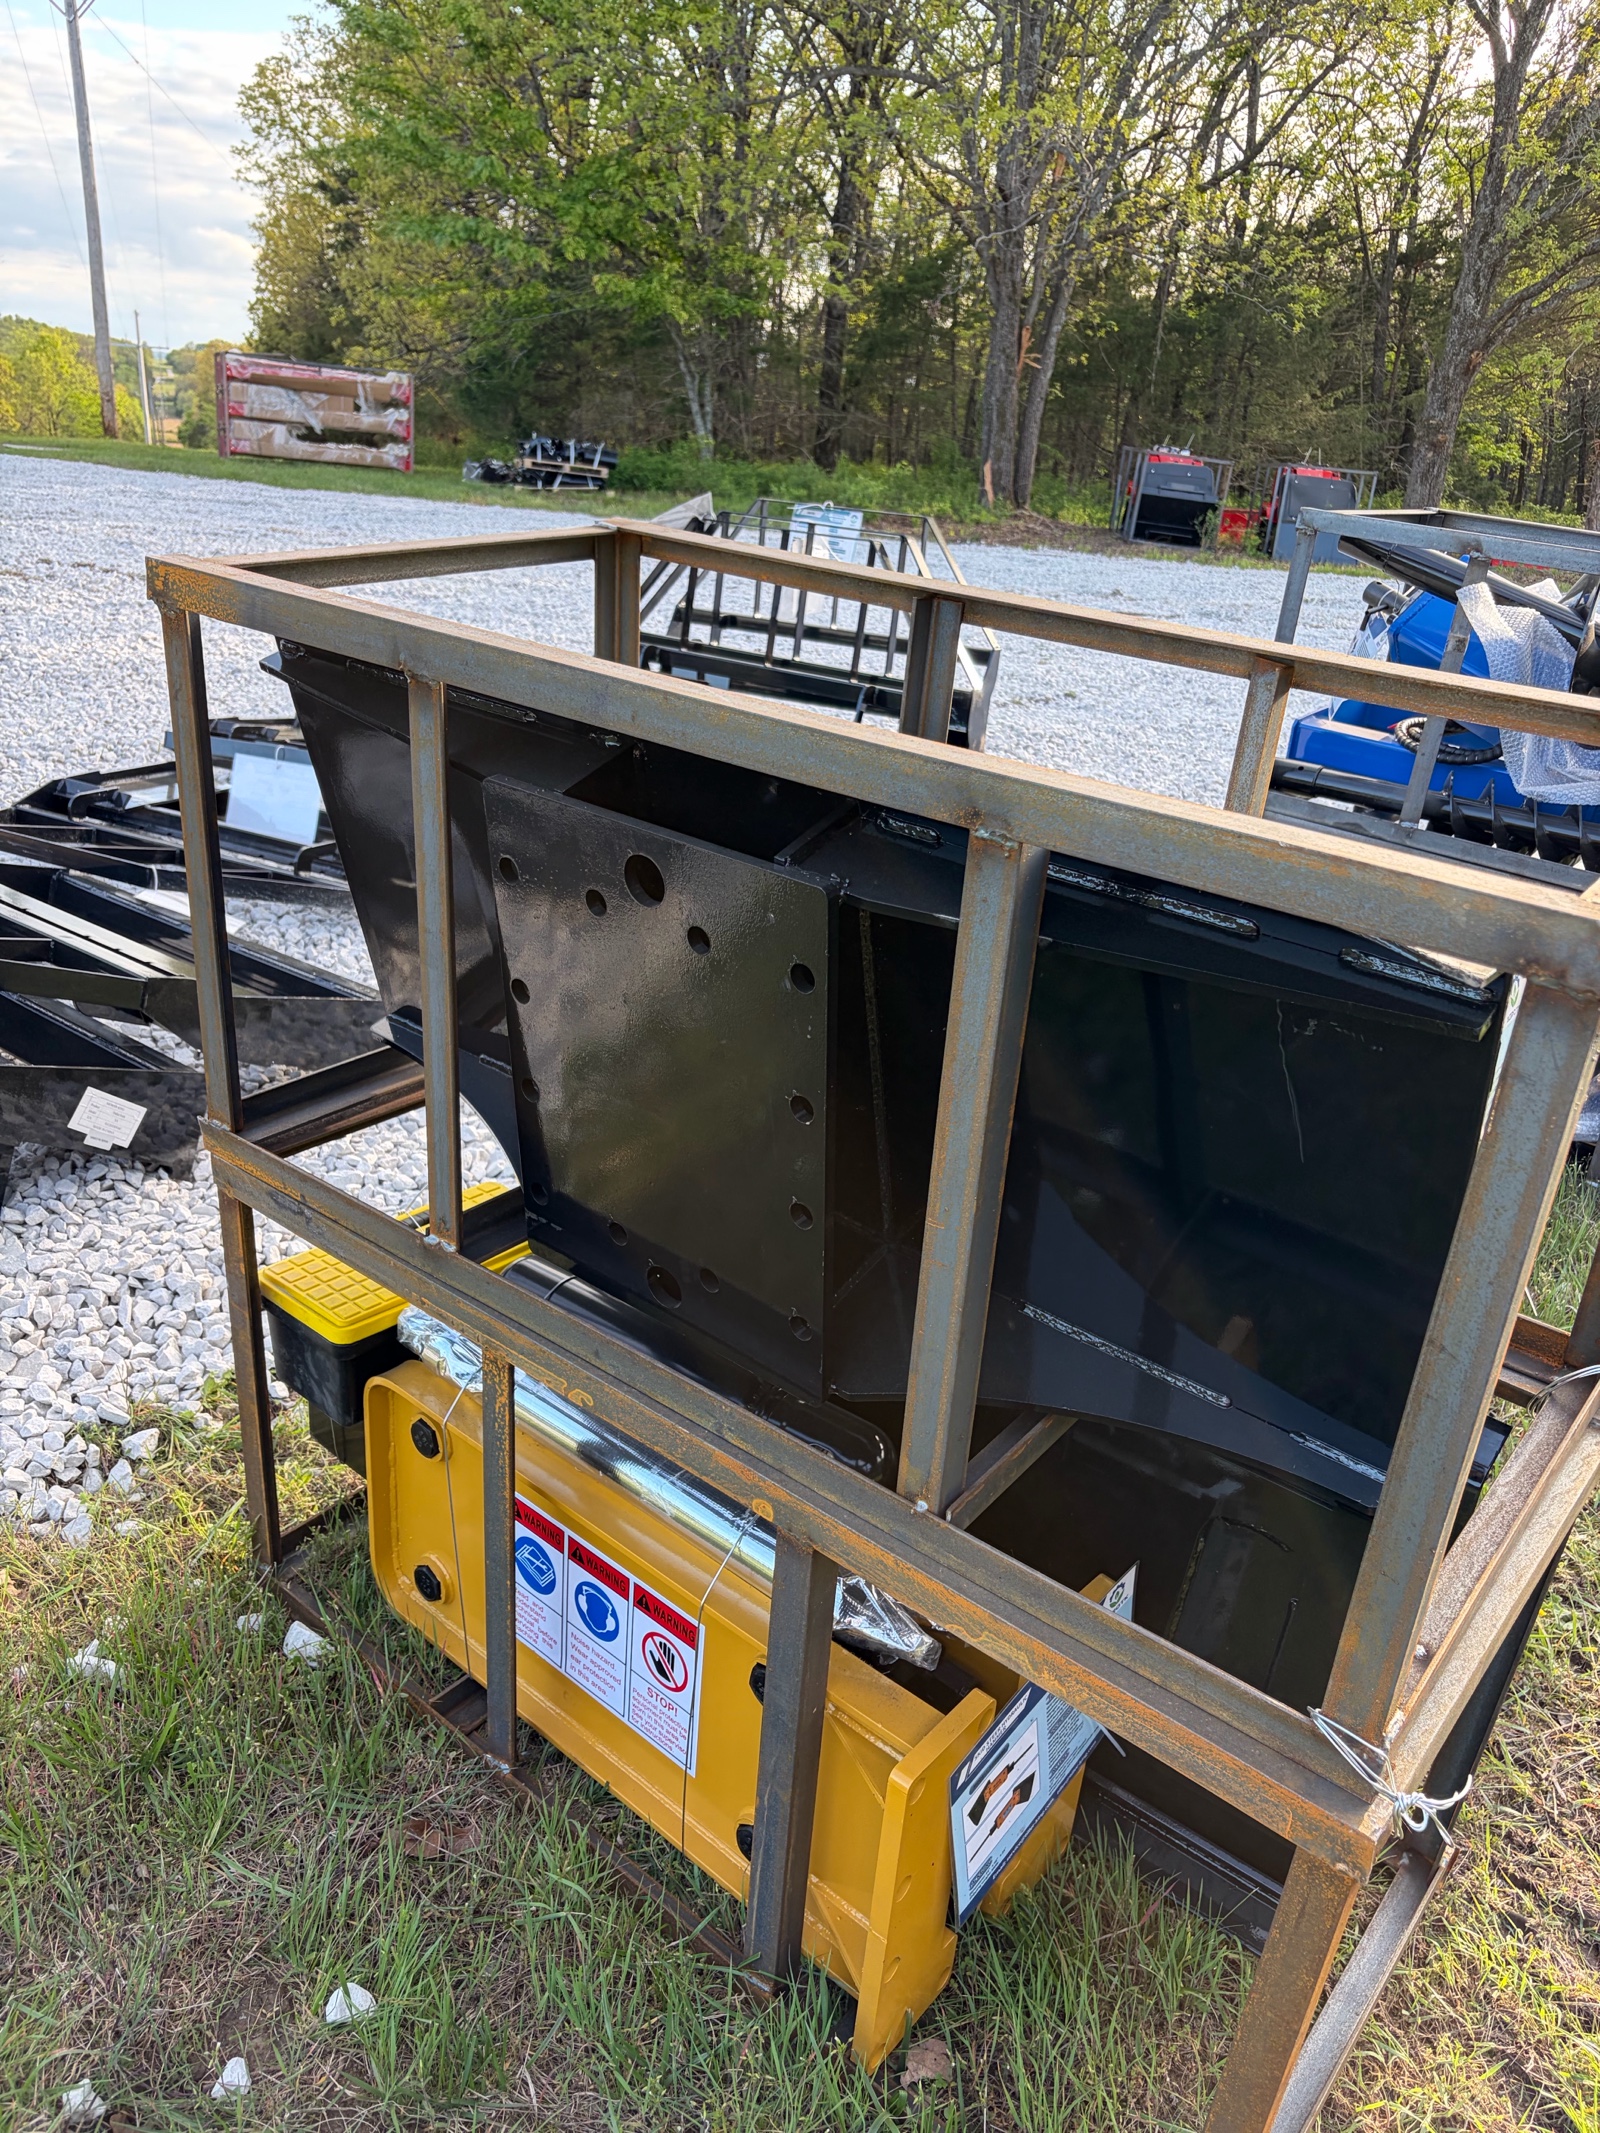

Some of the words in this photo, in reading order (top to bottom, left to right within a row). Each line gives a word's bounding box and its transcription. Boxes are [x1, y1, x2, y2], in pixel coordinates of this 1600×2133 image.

[523, 1509, 561, 1546] WARNING
[585, 1555, 627, 1592] WARNING
[532, 1601, 544, 1613] and
[652, 1604, 695, 1643] WARNING
[538, 1626, 557, 1645] before
[542, 1637, 553, 1650] this
[570, 1631, 590, 1651] Noise
[591, 1647, 617, 1671] hazard.
[570, 1641, 588, 1660] Wear
[590, 1658, 621, 1686] approved
[570, 1654, 581, 1665] ear
[583, 1663, 616, 1692] protection
[570, 1662, 576, 1673] in
[577, 1668, 589, 1683] this
[591, 1680, 608, 1697] area.
[631, 1708, 643, 1721] See
[644, 1719, 658, 1732] your
[632, 1686, 658, 1711] Personal
[659, 1708, 687, 1734] protective
[632, 1695, 662, 1721] equipment
[663, 1719, 679, 1735] must
[679, 1730, 687, 1741] be
[646, 1686, 678, 1718] STOP!
[631, 1714, 639, 1725] for
[640, 1721, 675, 1753] instructions.
[632, 1701, 646, 1717] worn
[653, 1718, 665, 1731] this
[665, 1728, 681, 1744] area.
[974, 1745, 986, 1761] SKID
[986, 1726, 1001, 1745] STEER
[1001, 1694, 1028, 1728] HYDRAULIC
